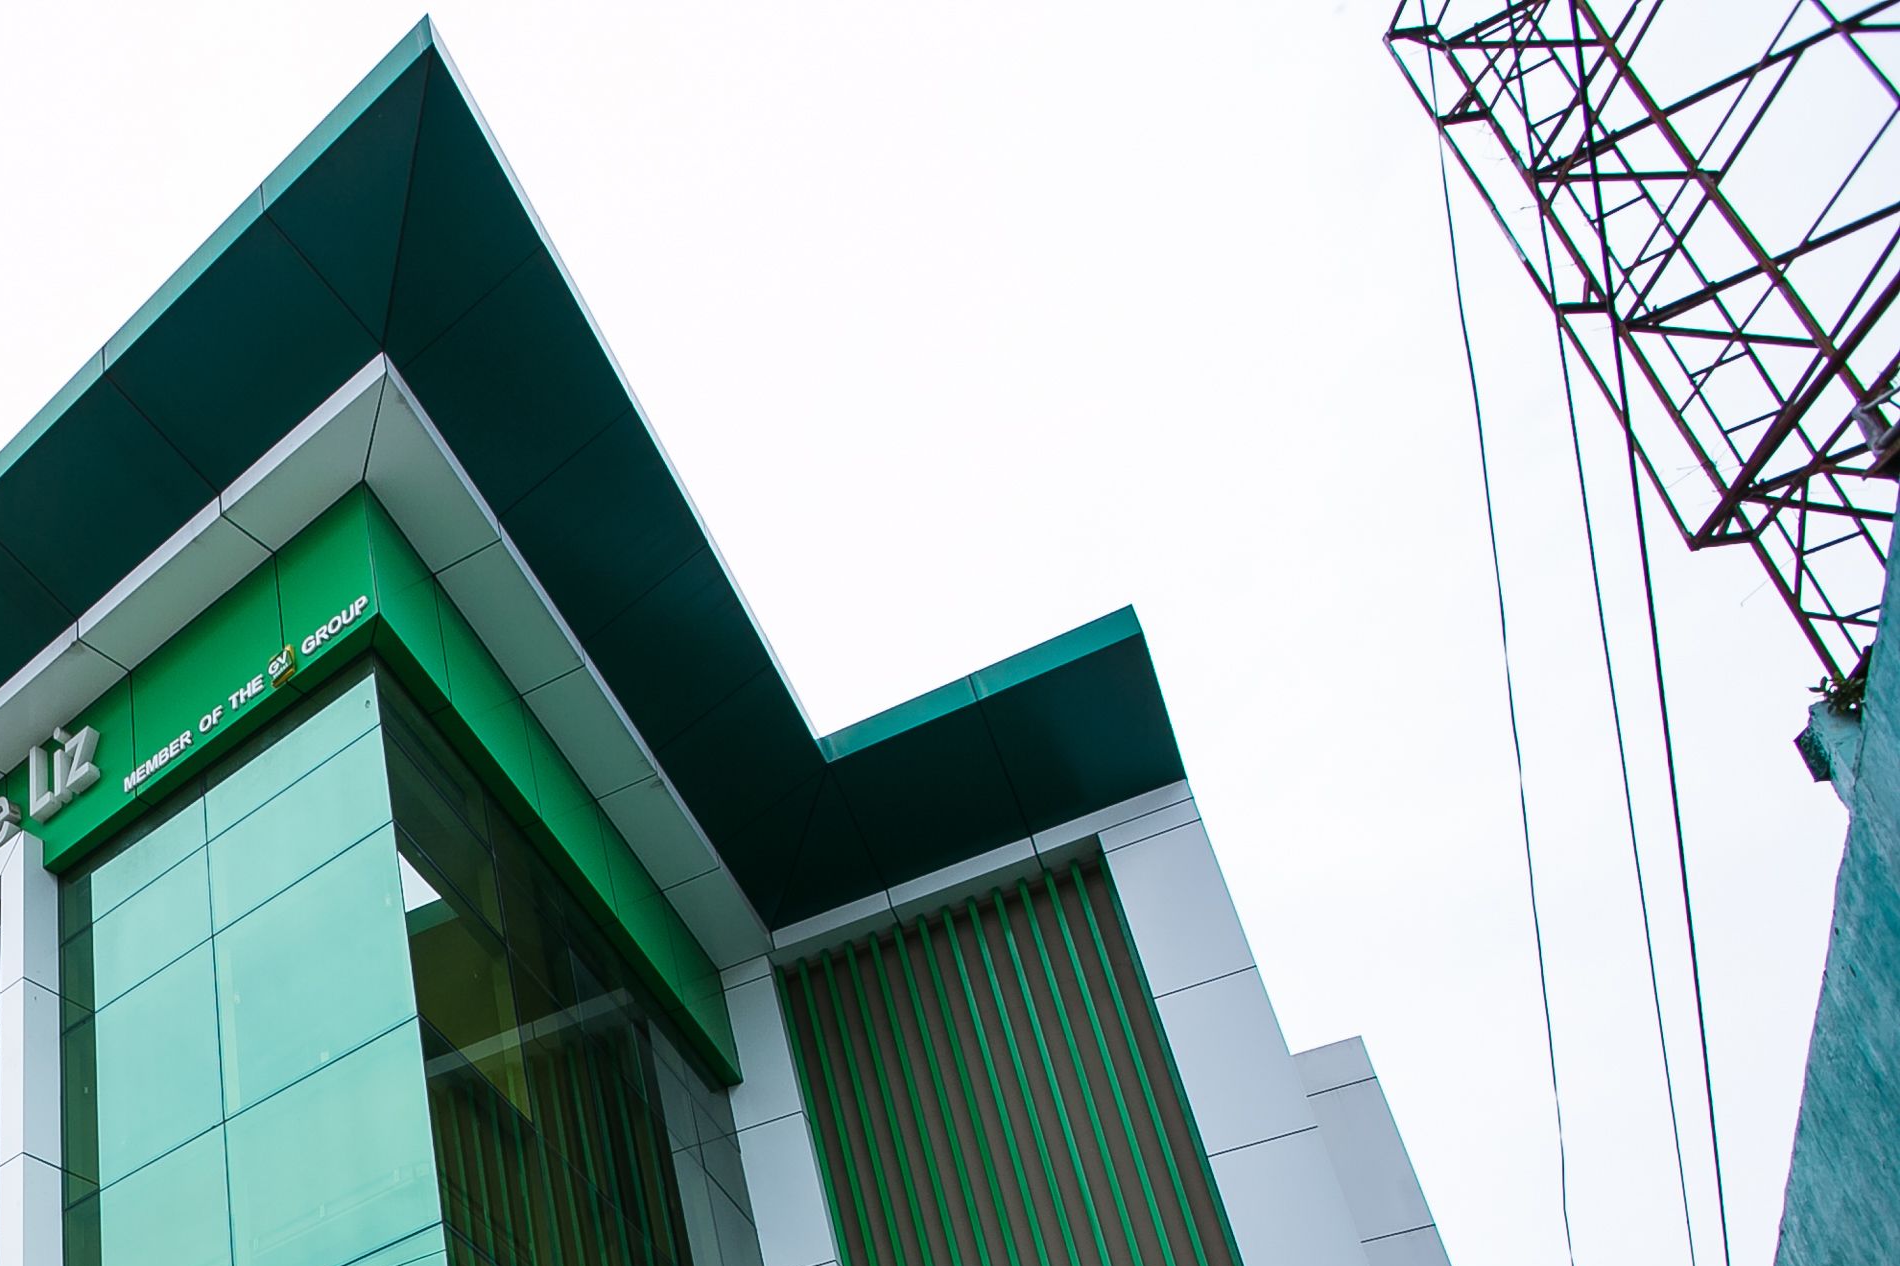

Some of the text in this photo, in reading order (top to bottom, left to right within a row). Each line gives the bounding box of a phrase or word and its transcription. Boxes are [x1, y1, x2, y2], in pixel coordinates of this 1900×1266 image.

[123, 595, 368, 793] MEMBER OF THE GV GROUP
[29, 725, 100, 824] Liz
